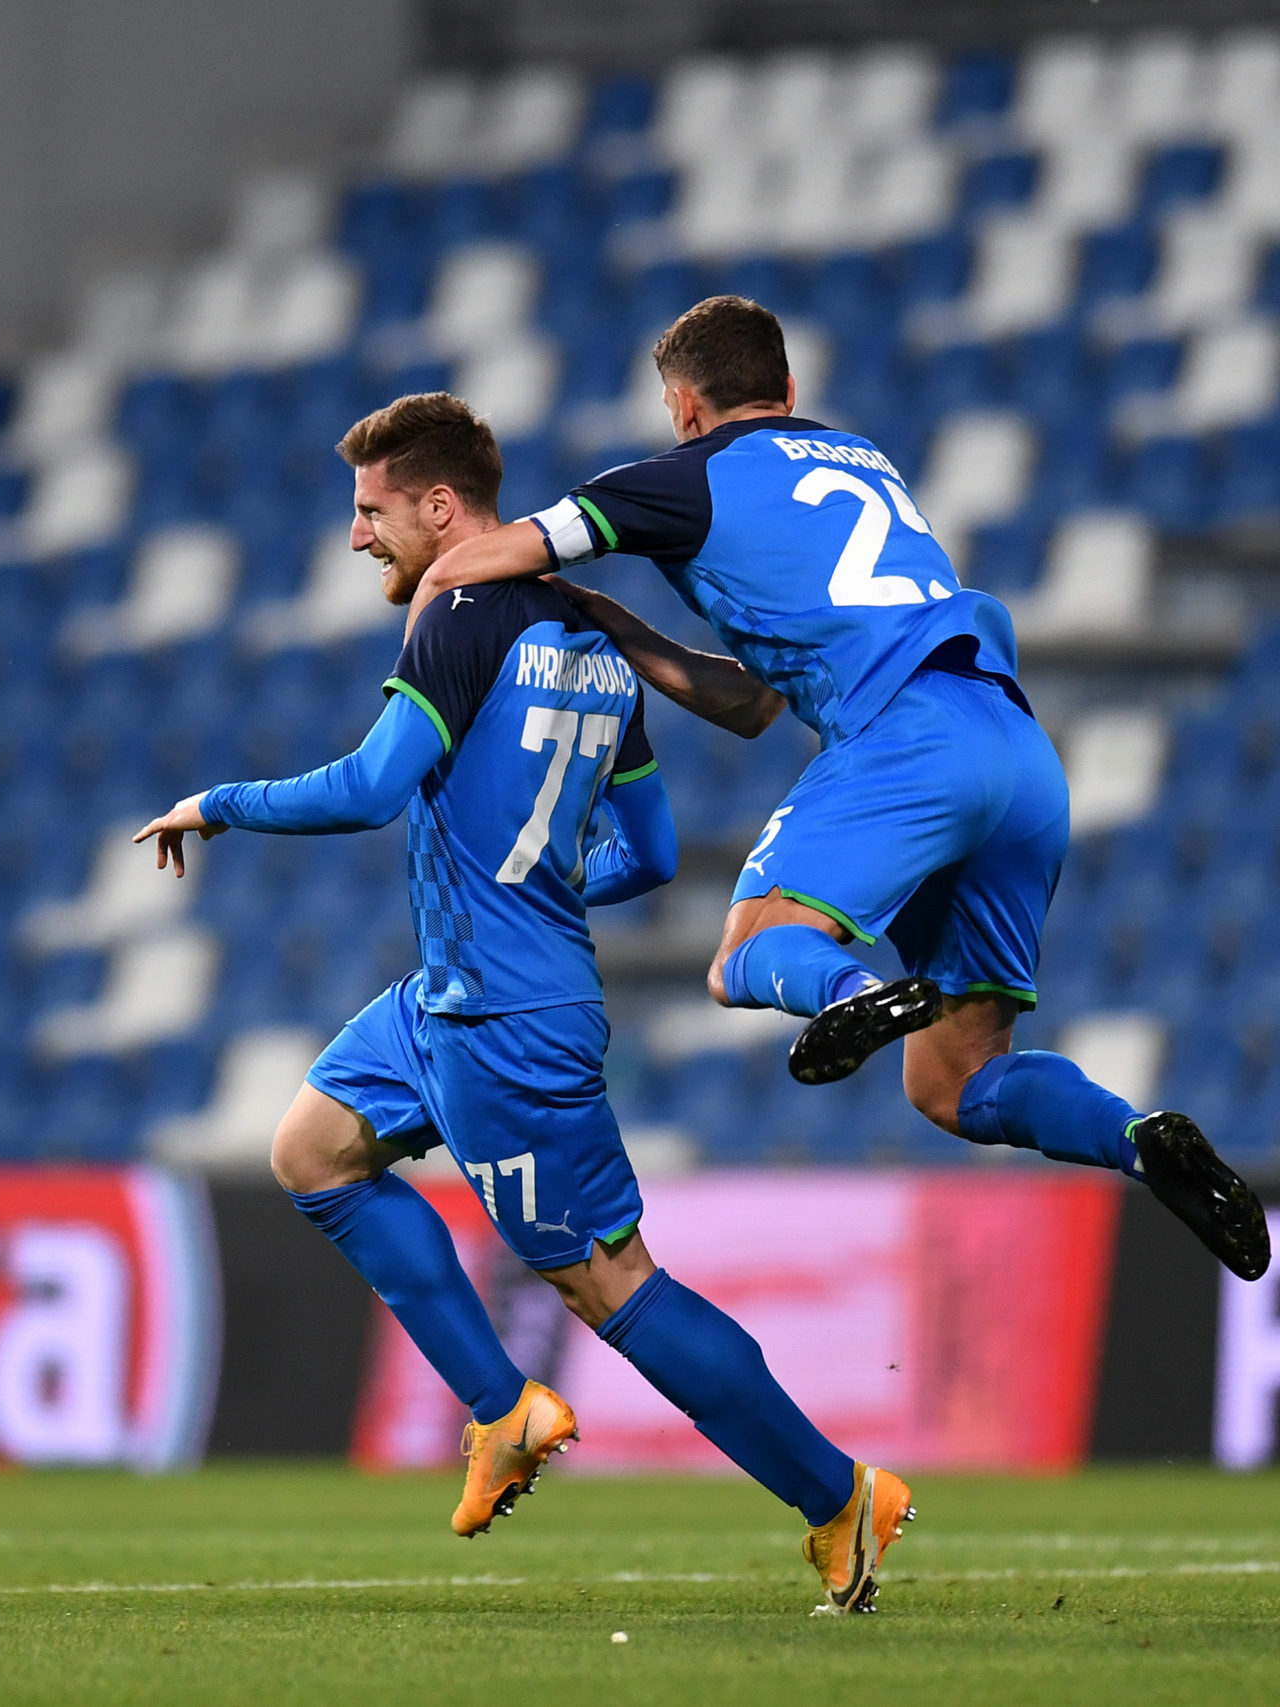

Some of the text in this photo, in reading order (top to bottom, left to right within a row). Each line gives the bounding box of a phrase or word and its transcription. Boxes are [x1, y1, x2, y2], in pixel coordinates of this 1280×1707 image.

[771, 437, 907, 489] BERARD
[495, 705, 621, 888] 77
[464, 1151, 536, 1223] 77
